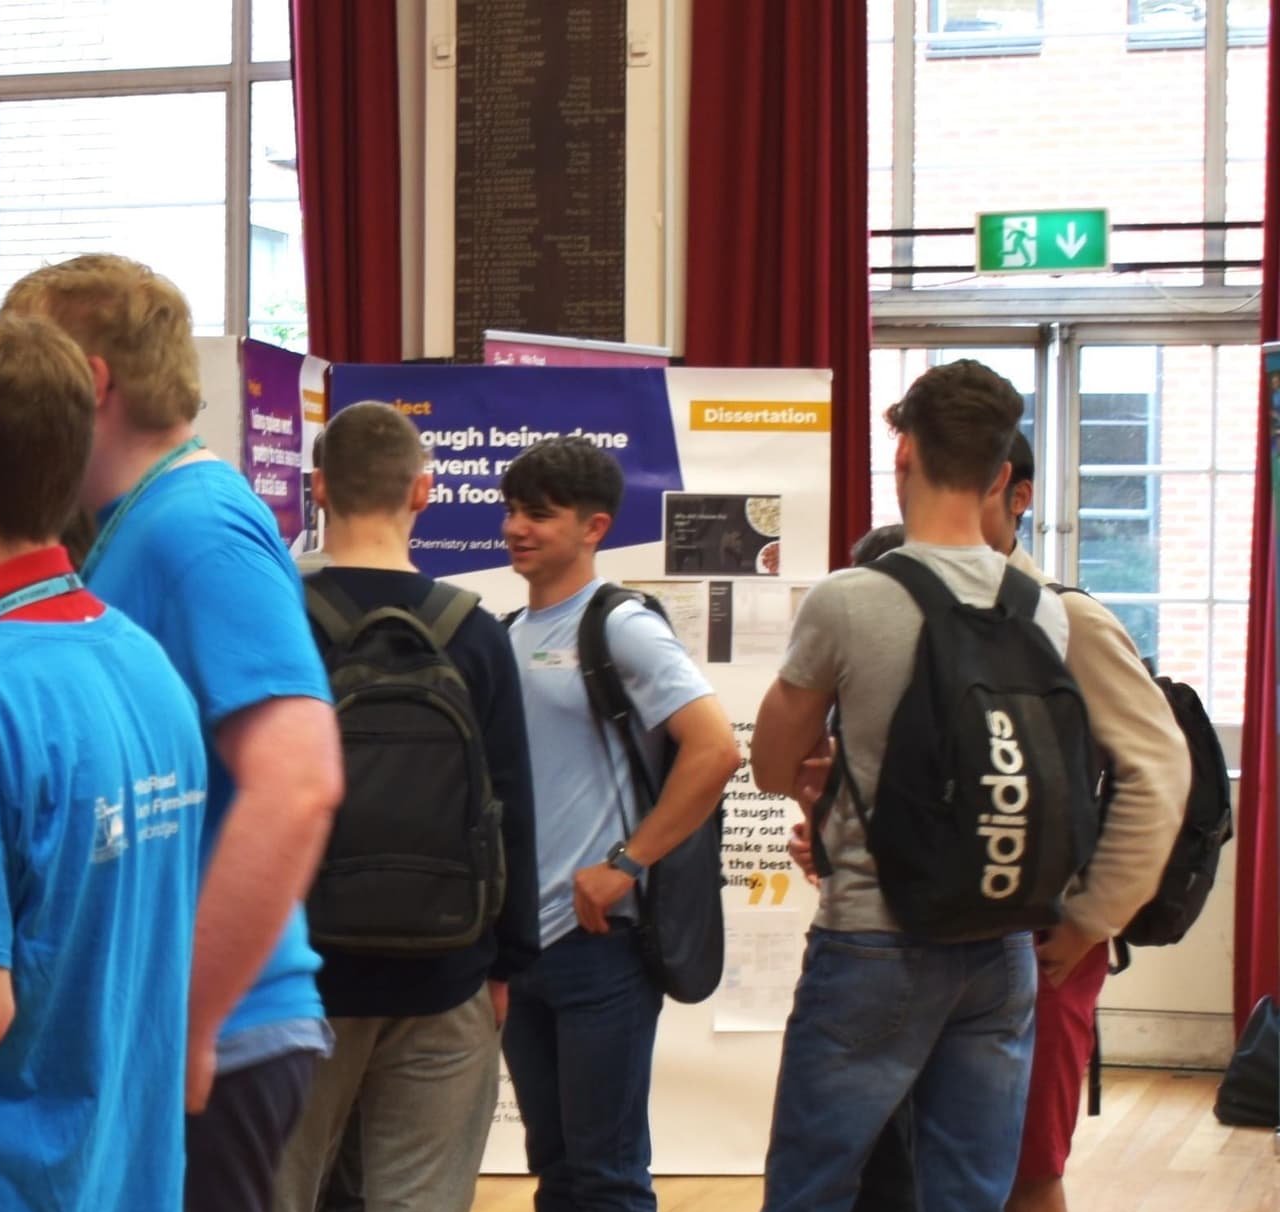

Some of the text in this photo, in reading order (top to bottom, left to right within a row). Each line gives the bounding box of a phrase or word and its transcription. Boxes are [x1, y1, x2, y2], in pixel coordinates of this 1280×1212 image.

[393, 399, 432, 415] ject
[703, 407, 818, 424] Dissertation
[419, 427, 484, 451] ough
[489, 425, 560, 448] bein
[423, 457, 490, 476] event
[457, 483, 506, 505] foo
[408, 538, 468, 552] Chemistry
[469, 539, 492, 550] and
[976, 709, 1029, 899] adidas
[733, 808, 785, 821] taught
[724, 826, 785, 838] arry out
[728, 858, 792, 870] the best
